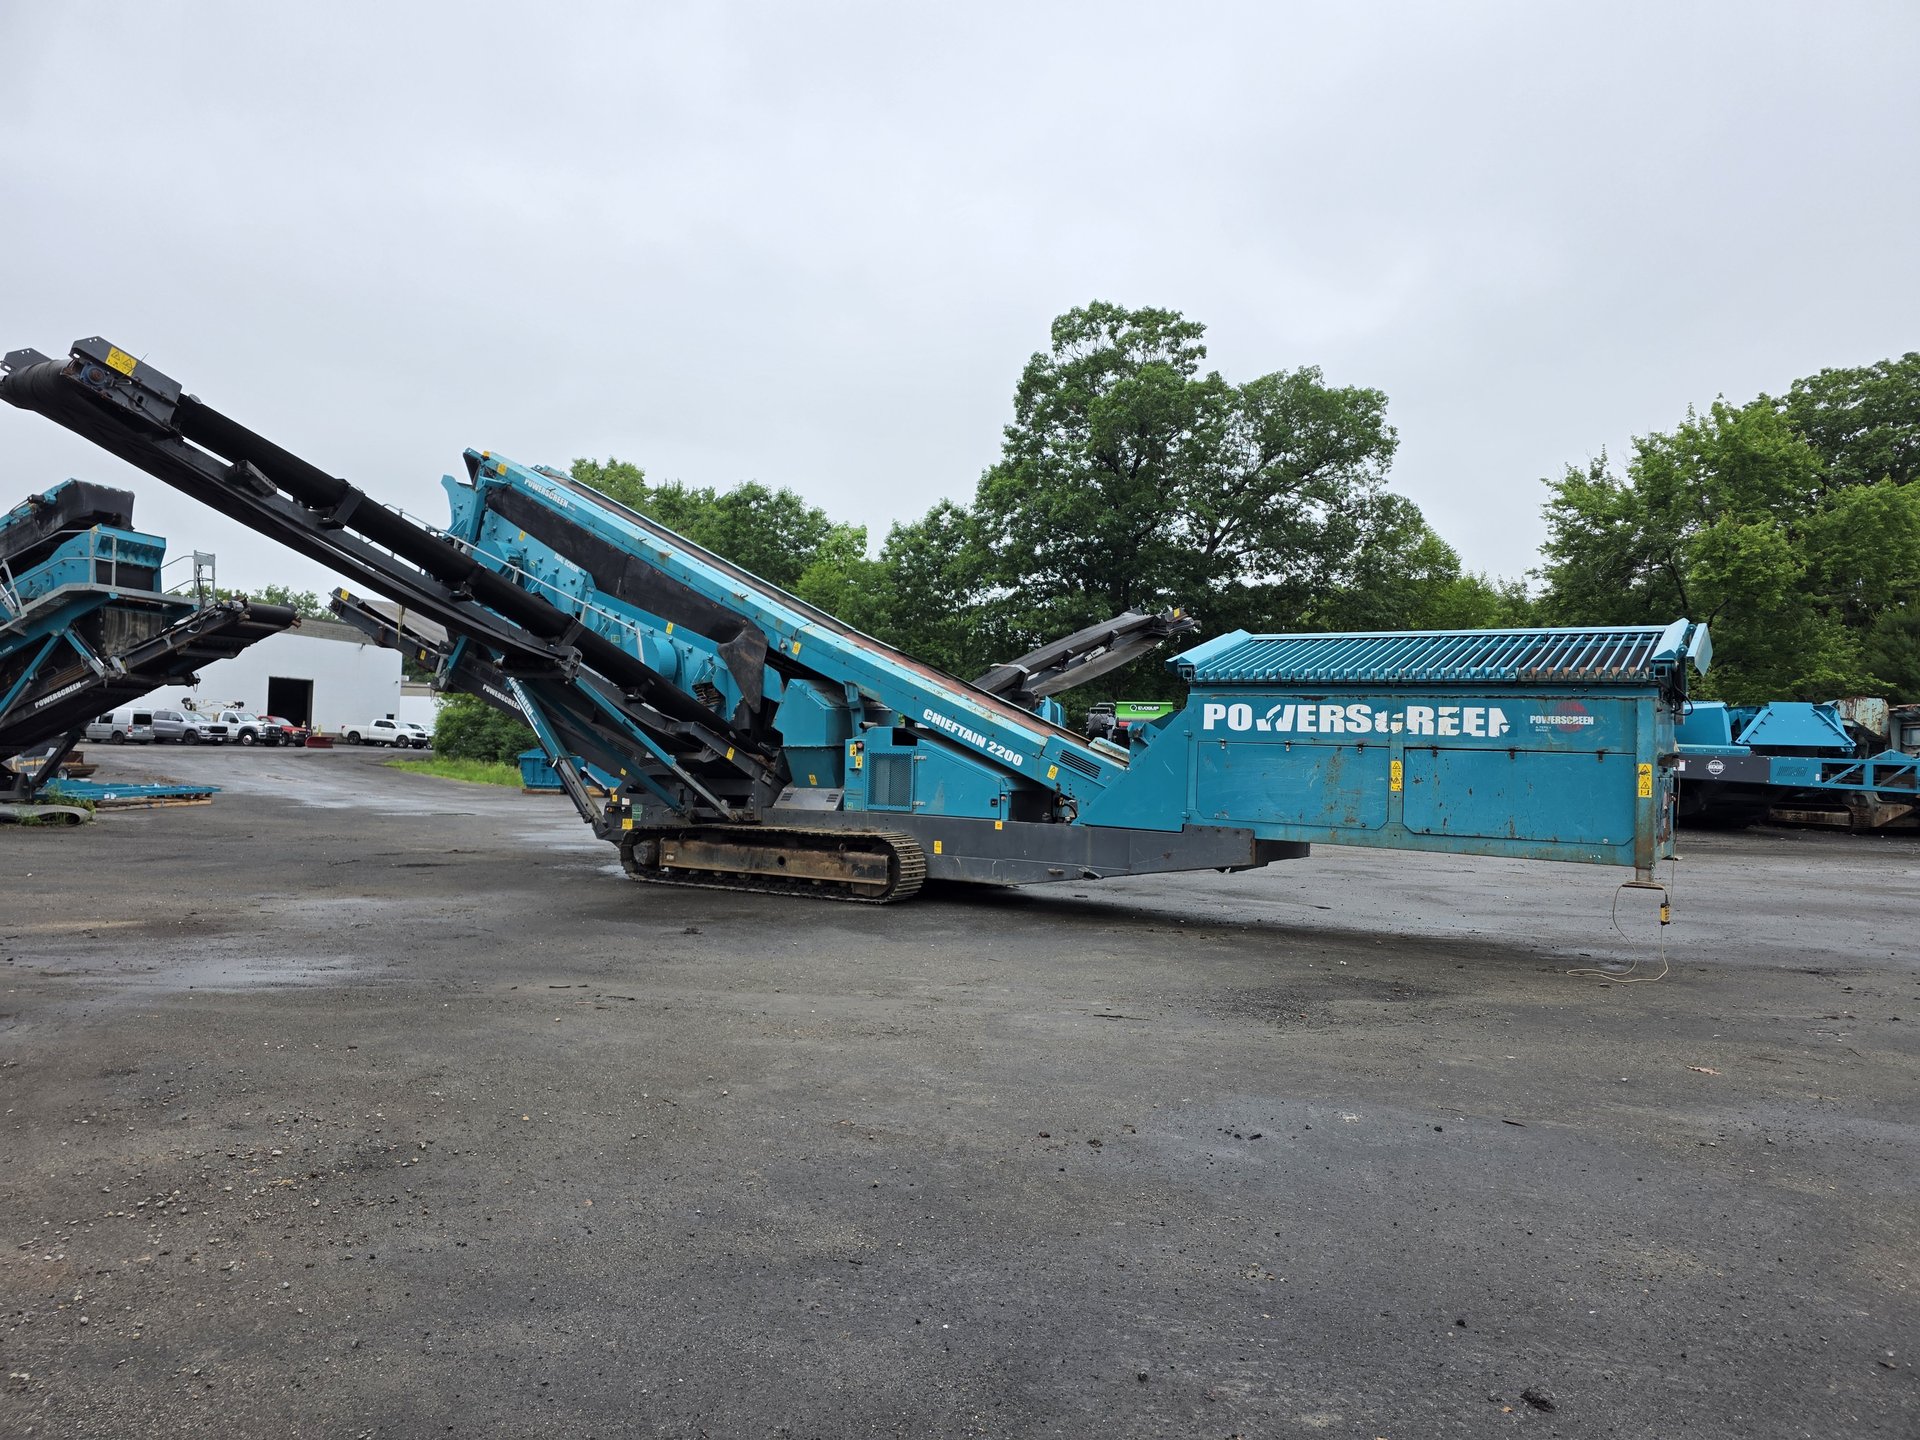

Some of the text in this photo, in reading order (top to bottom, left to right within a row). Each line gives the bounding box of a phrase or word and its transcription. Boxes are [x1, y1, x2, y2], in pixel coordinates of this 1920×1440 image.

[524, 478, 569, 508] POWERSCREEN
[34, 681, 82, 709] POWERSCREEN
[1529, 715, 1594, 725] POWERSCREEN
[922, 708, 1024, 767] CHIEFTAIN 2200
